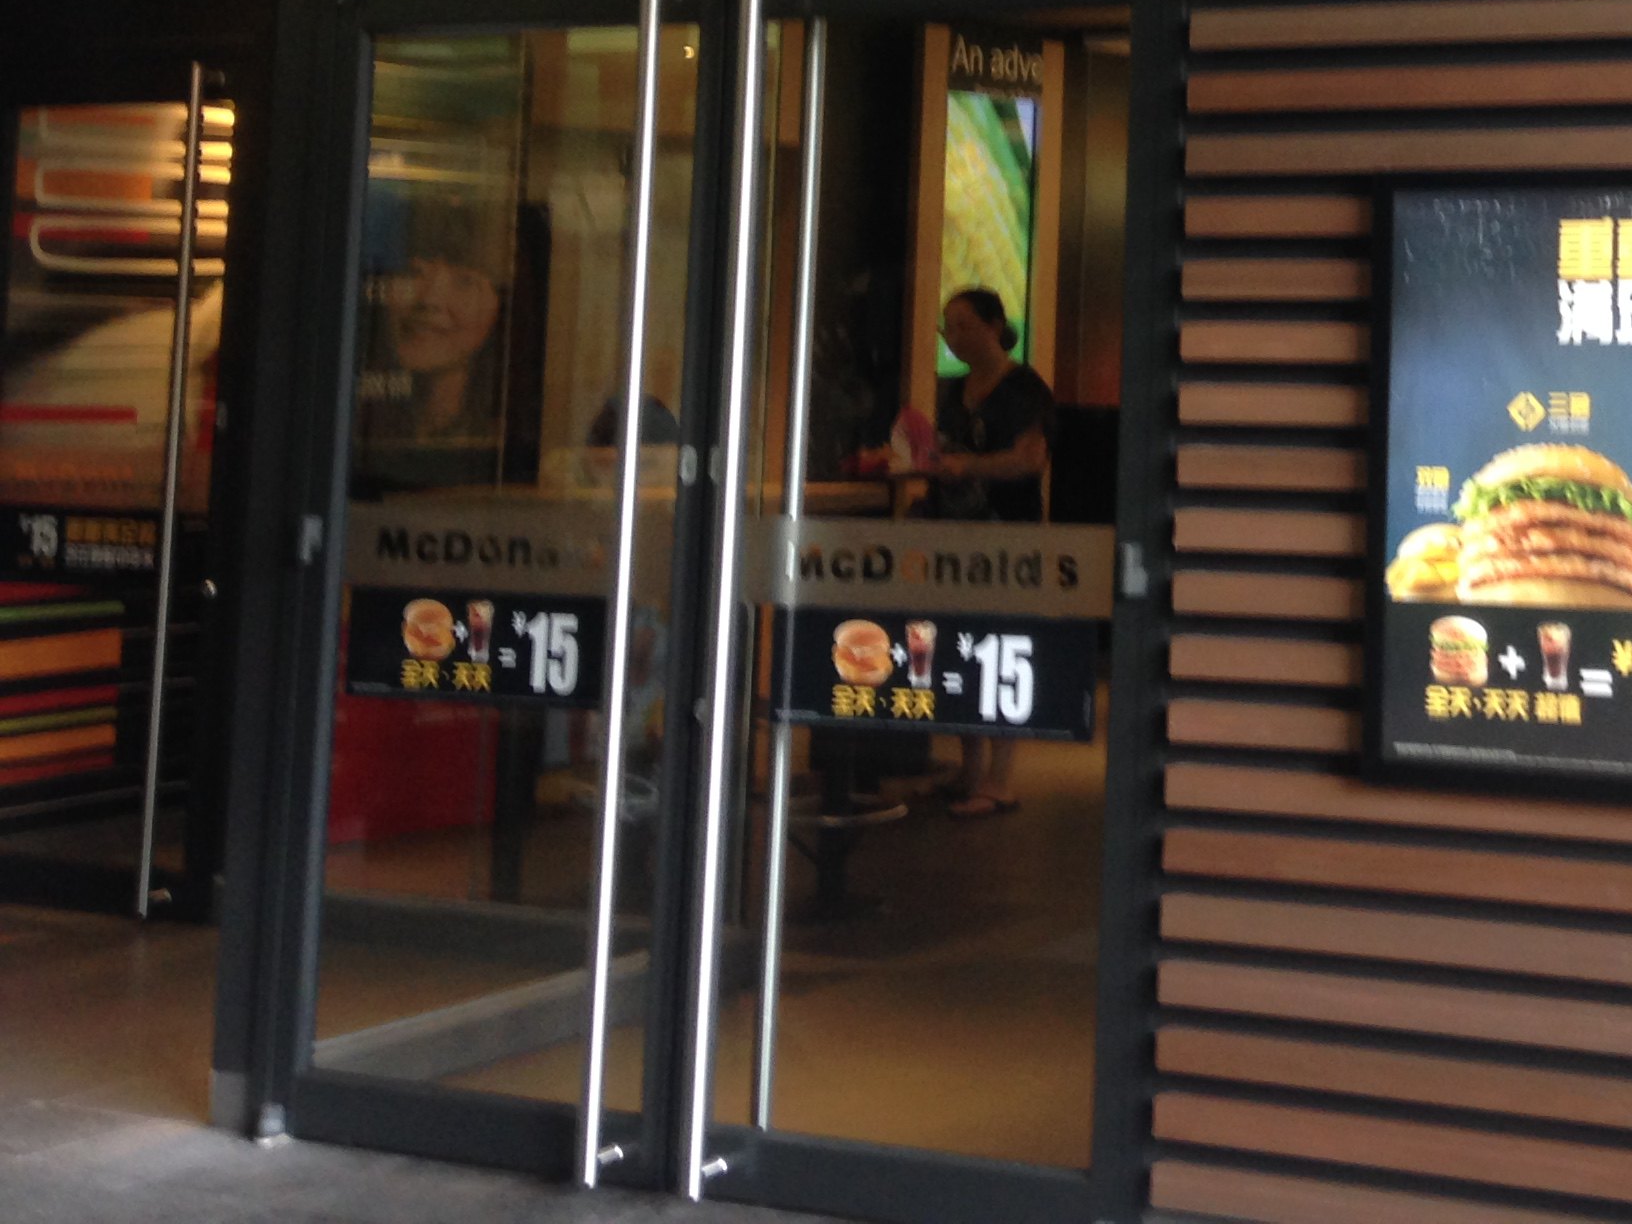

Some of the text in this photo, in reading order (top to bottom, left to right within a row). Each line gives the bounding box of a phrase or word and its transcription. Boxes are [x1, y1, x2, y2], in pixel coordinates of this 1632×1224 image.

[952, 34, 984, 75] An
[798, 543, 1080, 590] McDonalds
[956, 632, 1034, 725] ¥15
